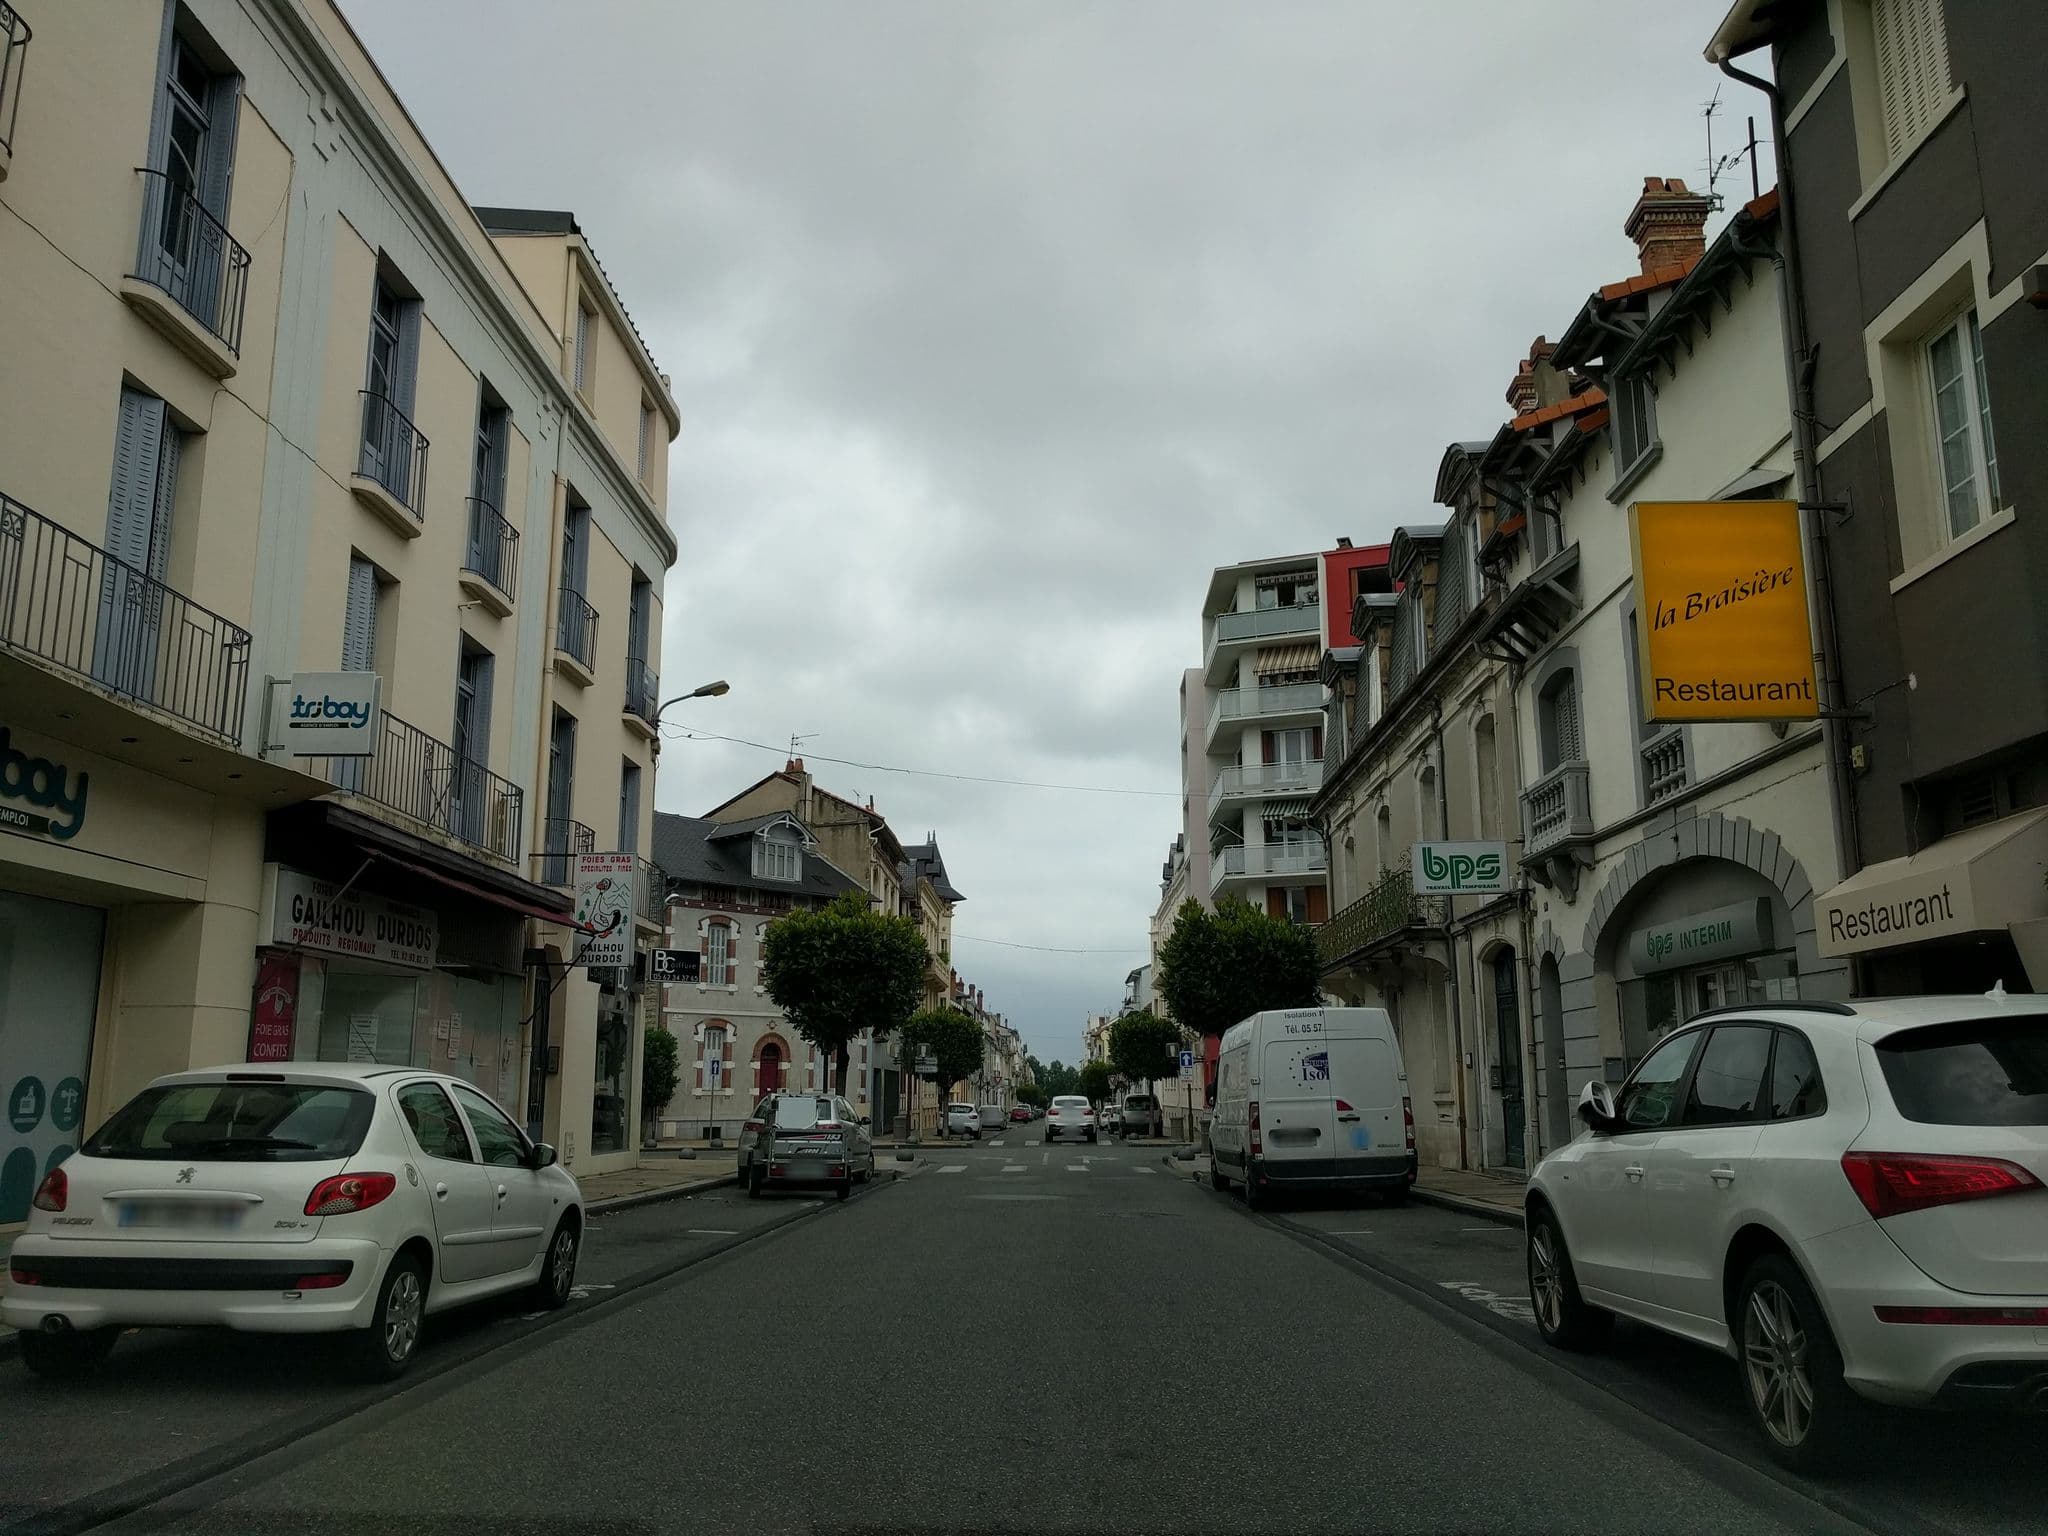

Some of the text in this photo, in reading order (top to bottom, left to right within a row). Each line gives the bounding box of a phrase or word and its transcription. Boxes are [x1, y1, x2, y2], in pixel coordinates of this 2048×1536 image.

[1654, 566, 1793, 631] la Braisière
[1655, 677, 1812, 702] Restaurant
[290, 694, 370, 729] tribay
[1422, 847, 1500, 889] bps
[292, 894, 365, 936] GAILHOU
[377, 914, 432, 951] DURDOS
[1829, 884, 1954, 943] Restaurant
[292, 928, 376, 955] PRODUITS REGIONAUX
[580, 943, 624, 952] GAILHOU
[1646, 920, 1732, 963] bps INTERIM
[581, 954, 622, 963] DURDOS
[1284, 1011, 1317, 1019] Isolation
[1301, 1024, 1311, 1033] 05
[1313, 1023, 1322, 1033] 57
[255, 1023, 273, 1036] FOIE
[253, 1043, 288, 1057] CONFITS
